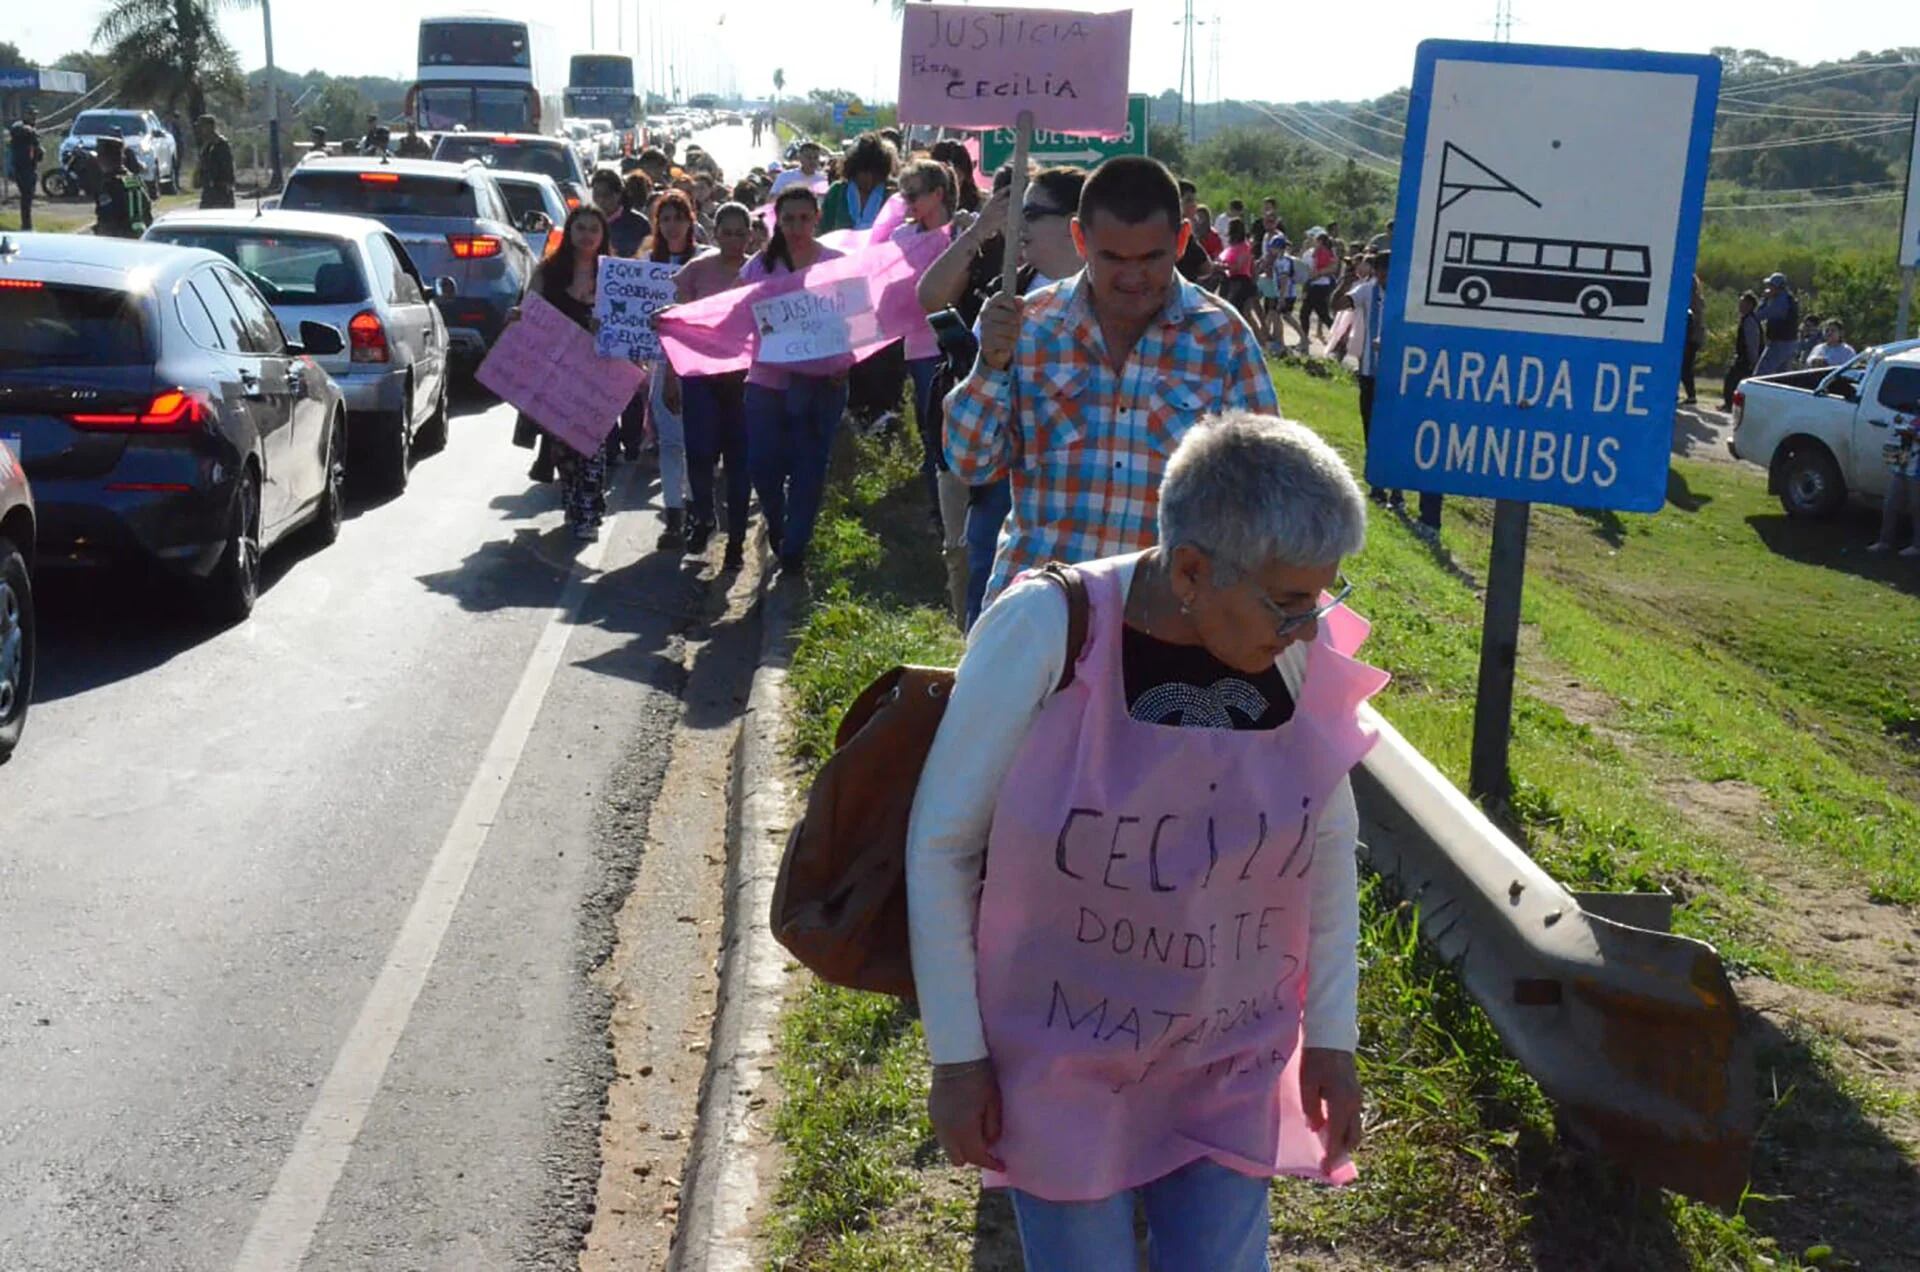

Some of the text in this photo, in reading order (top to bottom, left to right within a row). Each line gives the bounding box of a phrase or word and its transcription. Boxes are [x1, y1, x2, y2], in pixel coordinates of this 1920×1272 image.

[929, 9, 1089, 50] JUSTICIA
[1400, 346, 1652, 416] PARADA DE
[1414, 419, 1620, 488] OMNIBUS
